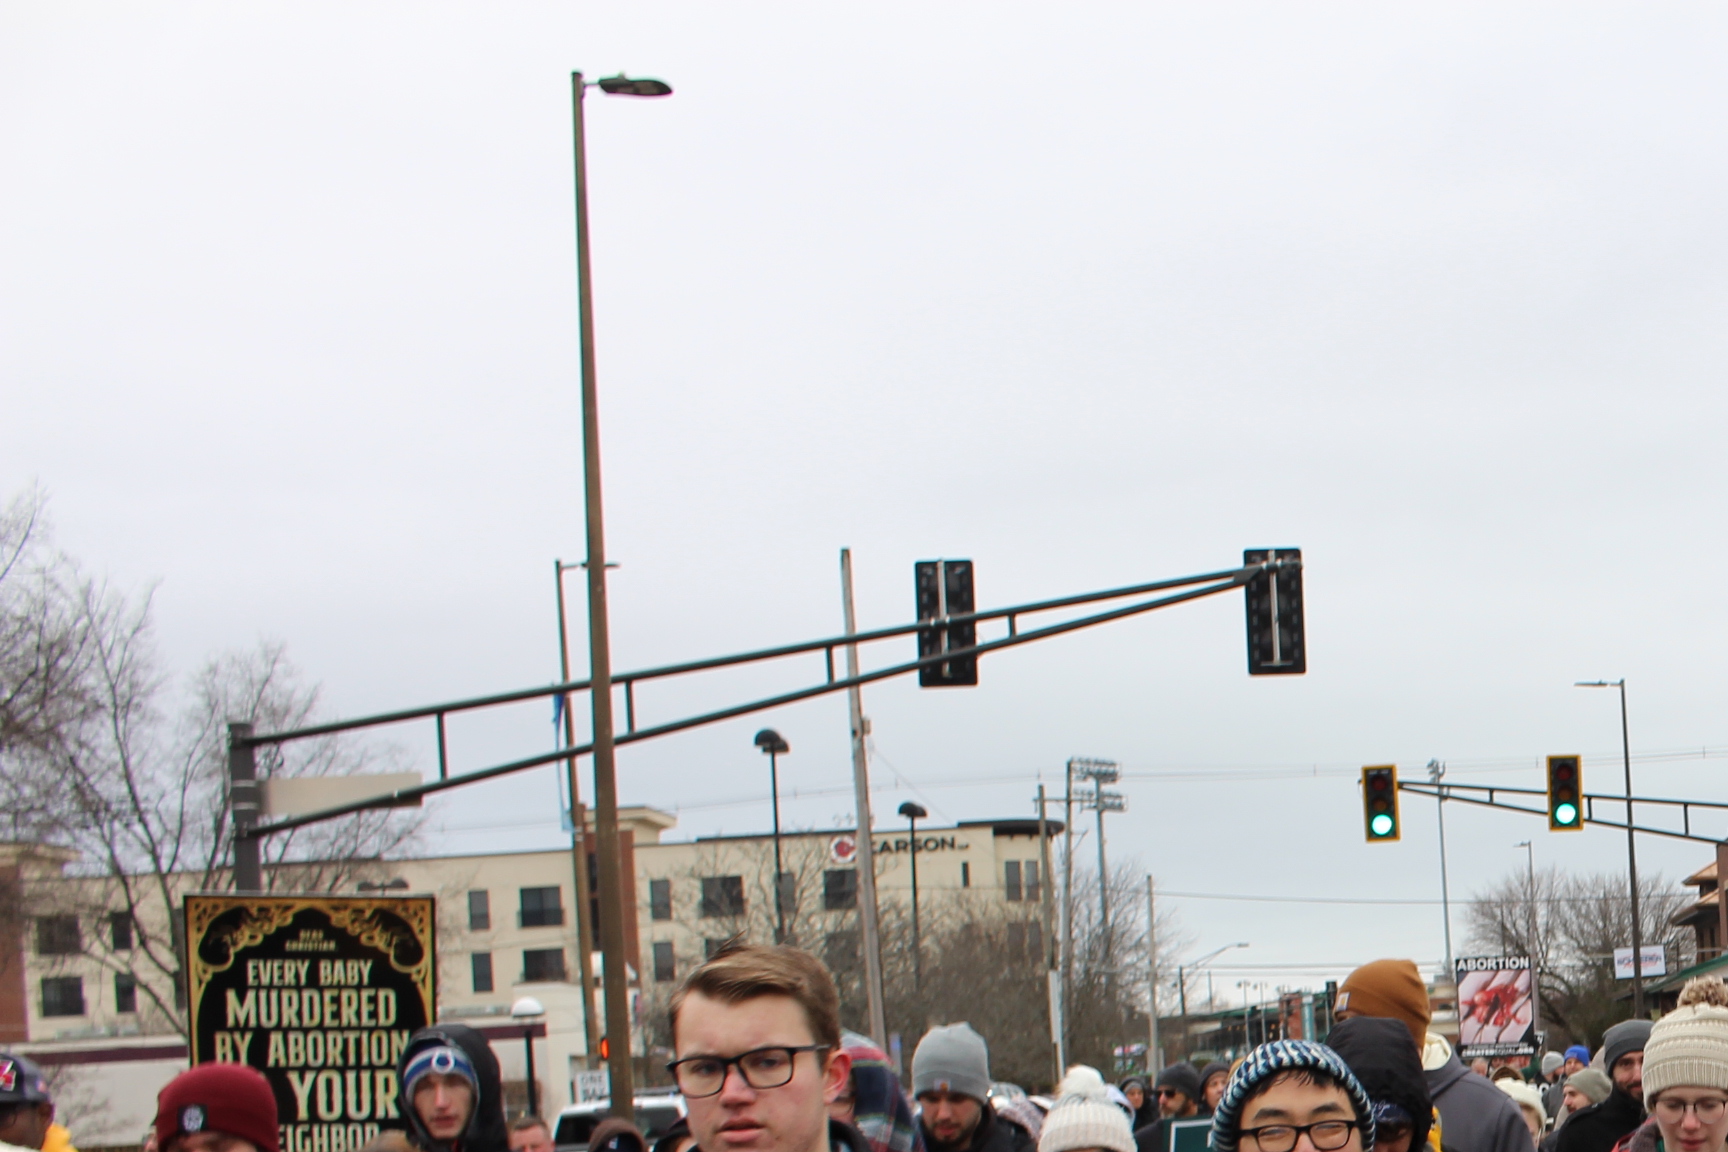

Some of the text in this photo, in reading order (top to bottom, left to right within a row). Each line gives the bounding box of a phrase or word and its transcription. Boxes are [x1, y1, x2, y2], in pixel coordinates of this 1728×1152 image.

[247, 959, 373, 986] EVERY BABY
[1457, 956, 1530, 971] ABORTION
[226, 988, 397, 1028] MURDERED
[215, 1030, 409, 1067] BY ABORTION
[287, 1069, 400, 1121] YOUR
